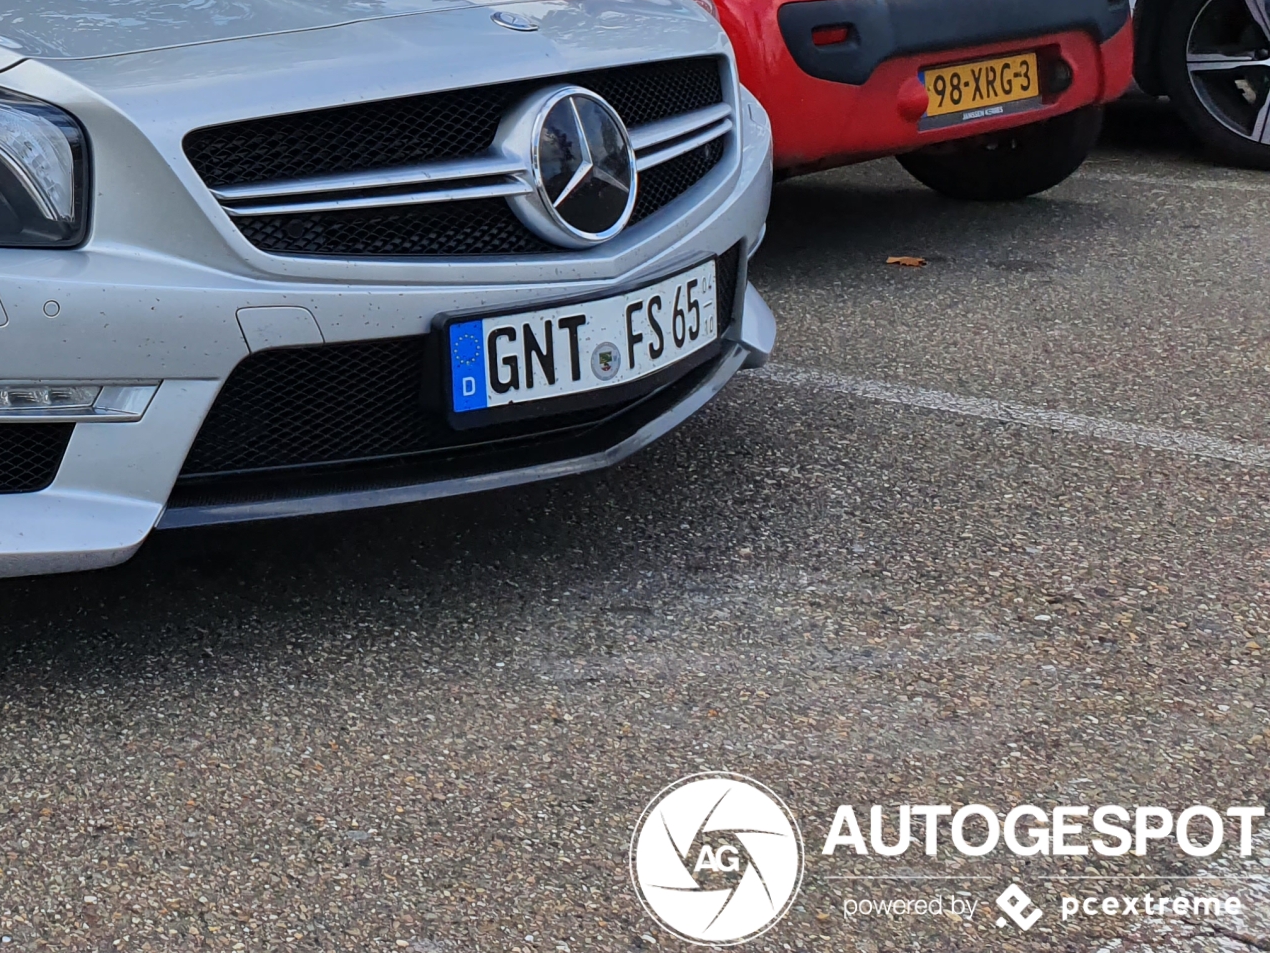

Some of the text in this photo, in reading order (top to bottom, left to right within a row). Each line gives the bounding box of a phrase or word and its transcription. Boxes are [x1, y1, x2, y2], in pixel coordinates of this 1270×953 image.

[933, 59, 1031, 108] 98-XRG-3
[462, 376, 476, 397] D
[487, 314, 587, 394] GNT
